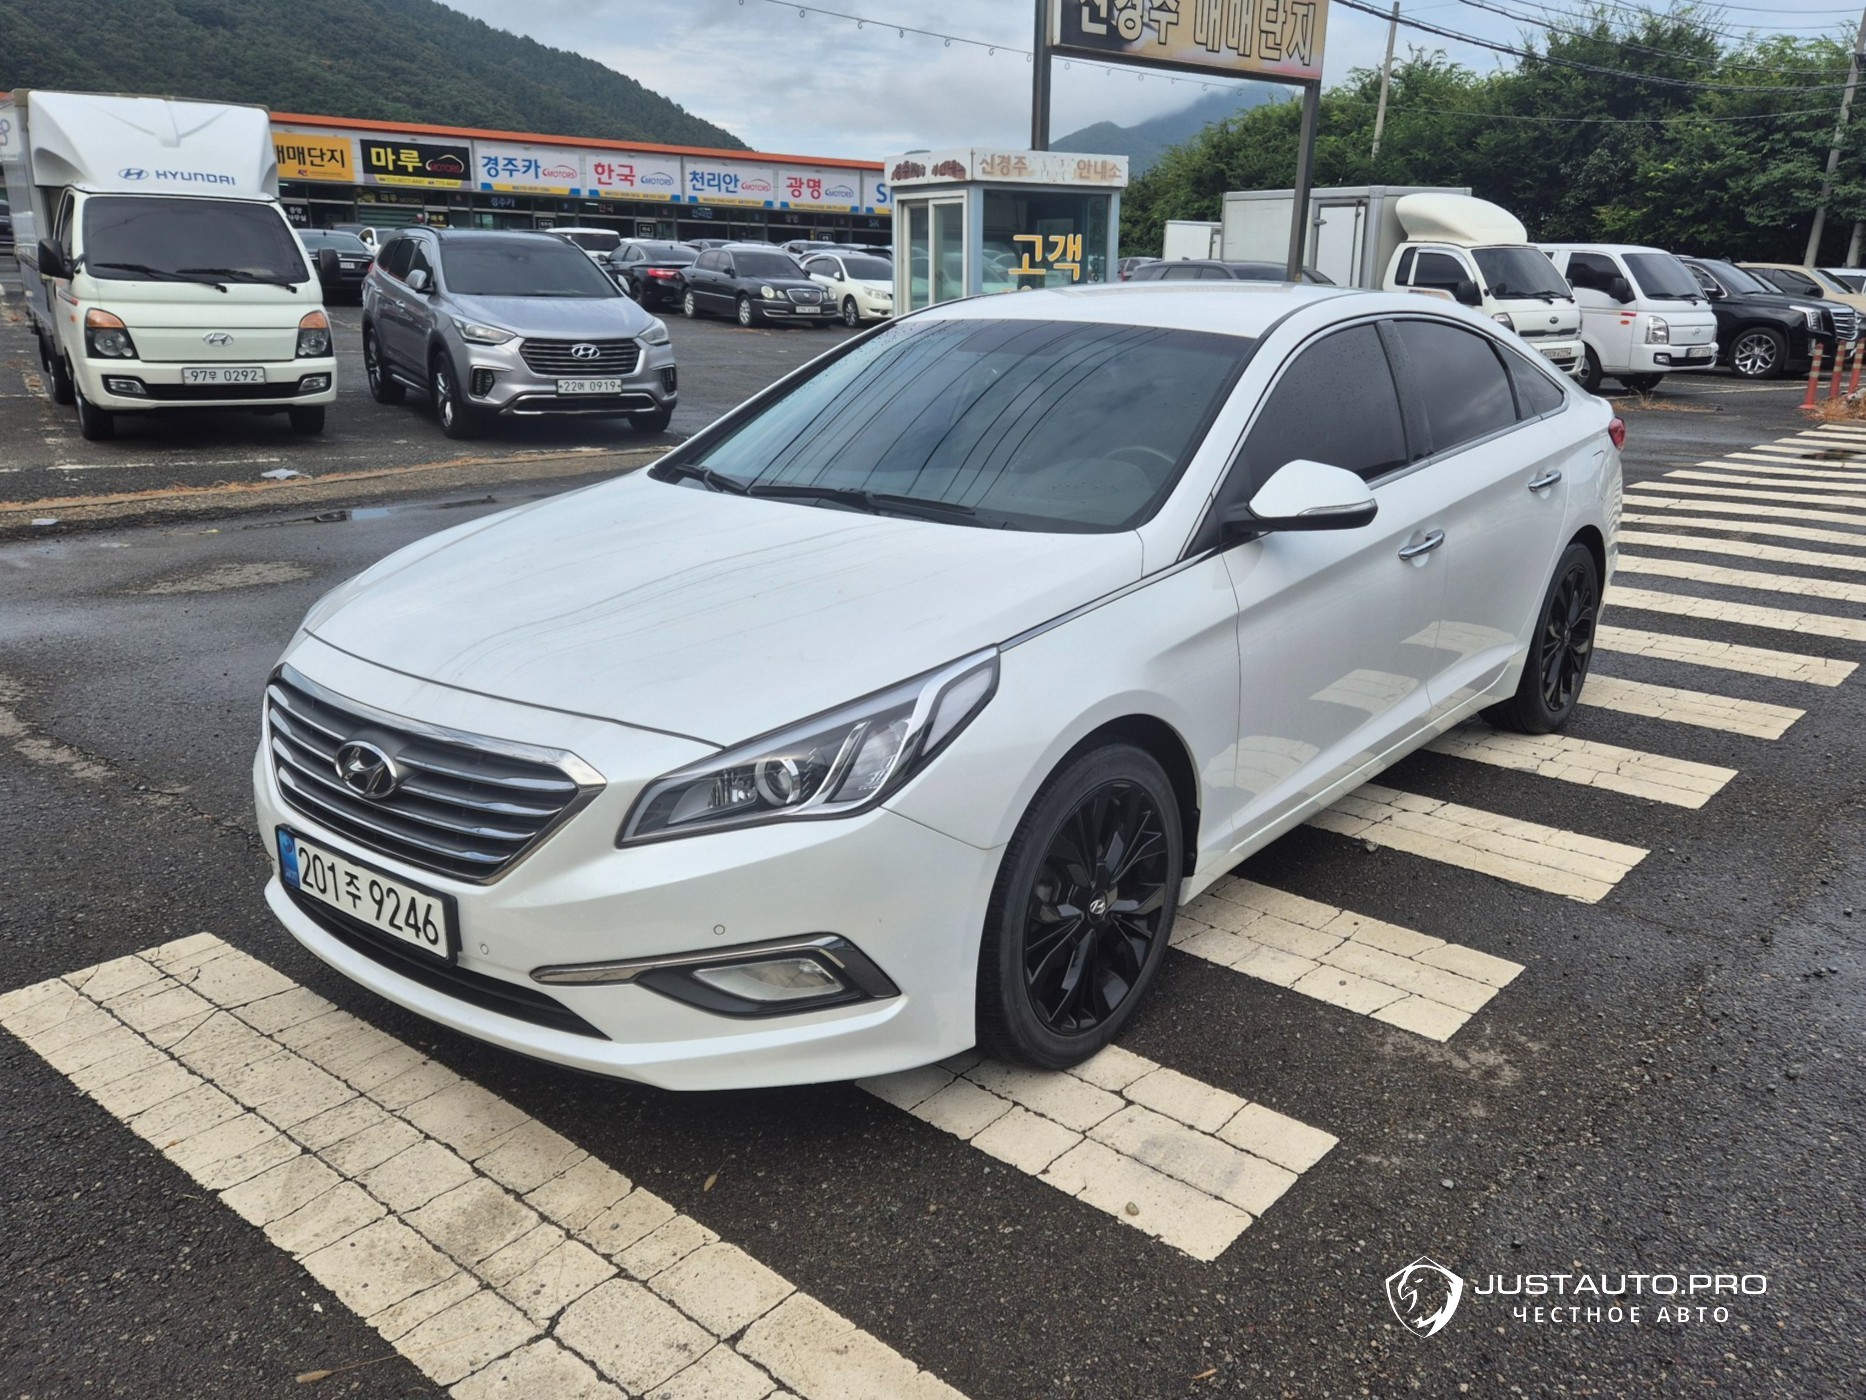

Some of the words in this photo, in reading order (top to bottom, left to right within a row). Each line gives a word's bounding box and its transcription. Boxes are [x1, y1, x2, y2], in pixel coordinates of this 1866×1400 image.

[1194, 0, 1317, 67] 매매단지
[370, 147, 423, 172] 마루
[430, 162, 462, 173] MOTORS
[481, 156, 541, 179] 경주카
[979, 153, 1029, 177] 신경주
[1076, 159, 1122, 180] 안내소
[155, 170, 236, 186] HYUNDAI
[546, 170, 576, 179] MOTORS
[594, 163, 636, 187] 한국
[645, 176, 673, 186] MOTORS
[689, 171, 740, 193] 천리안
[745, 184, 770, 192] MOTORS
[786, 177, 822, 200] 광명
[828, 190, 854, 198] MOTORS
[876, 183, 893, 204] S
[1008, 233, 1082, 281] 고객
[190, 370, 217, 382] 97무
[223, 370, 258, 382] 0292
[589, 381, 616, 391] 0919
[298, 846, 361, 909] 201주
[368, 879, 439, 946] 9246
